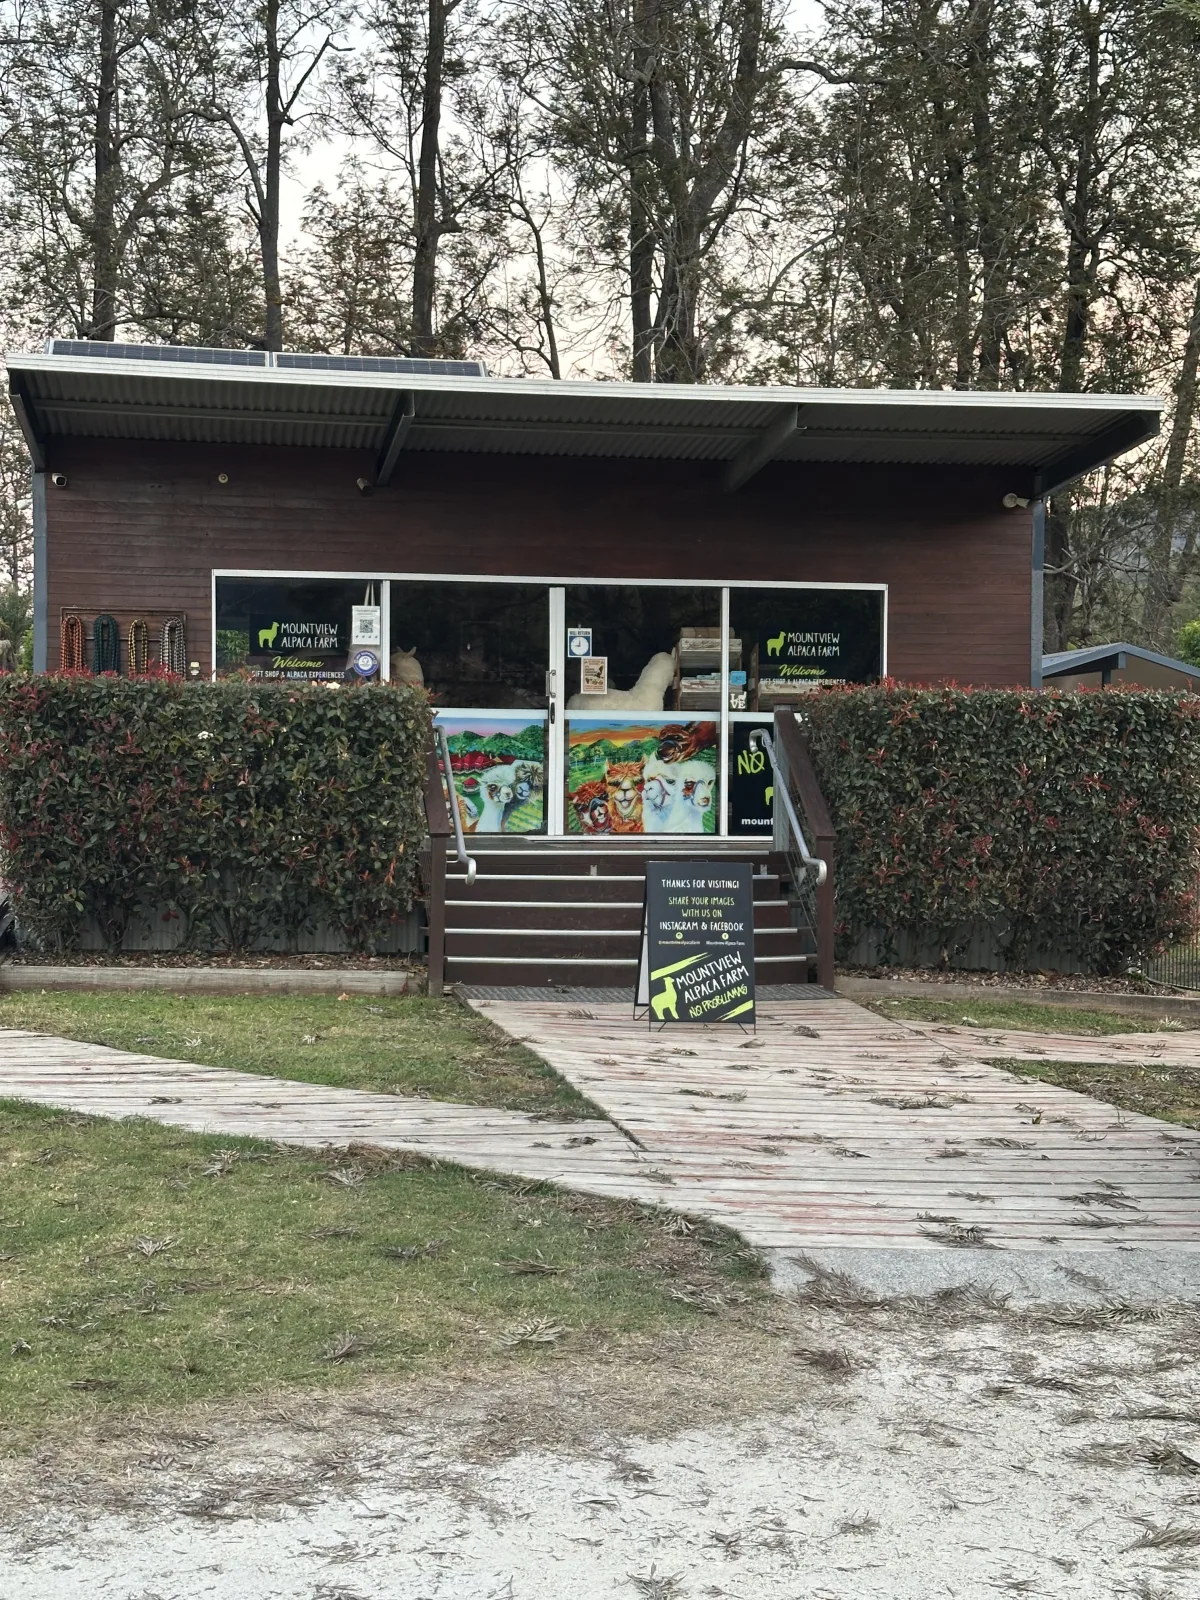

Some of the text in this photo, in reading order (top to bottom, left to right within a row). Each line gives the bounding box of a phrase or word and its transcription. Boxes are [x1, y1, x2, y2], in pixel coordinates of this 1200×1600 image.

[281, 623, 338, 635] MOUNTVIEW
[281, 636, 338, 648] ALPACA FARM
[787, 632, 840, 644] MOUNTVIEW
[787, 646, 840, 657] ALPACA FARM
[272, 655, 324, 669] Welcome
[251, 670, 263, 678] GIFT
[265, 670, 279, 678] SHOP
[287, 671, 307, 679] ALPACA
[308, 671, 345, 679] EXPERIENCES
[779, 664, 827, 677] Welcome
[813, 678, 846, 686] EXPERIENCES
[737, 750, 765, 775] NO
[662, 879, 740, 889] THANKS FOR VISITING!
[668, 896, 735, 906] SHARE YOUR IMAGES
[681, 908, 723, 918] WITH US ON
[660, 921, 744, 931] INSTAGRAM & FACEBOOK
[675, 951, 742, 990] MOUNTVIEW
[684, 965, 749, 1004] ALPACA FARM
[688, 1005, 703, 1019] NO
